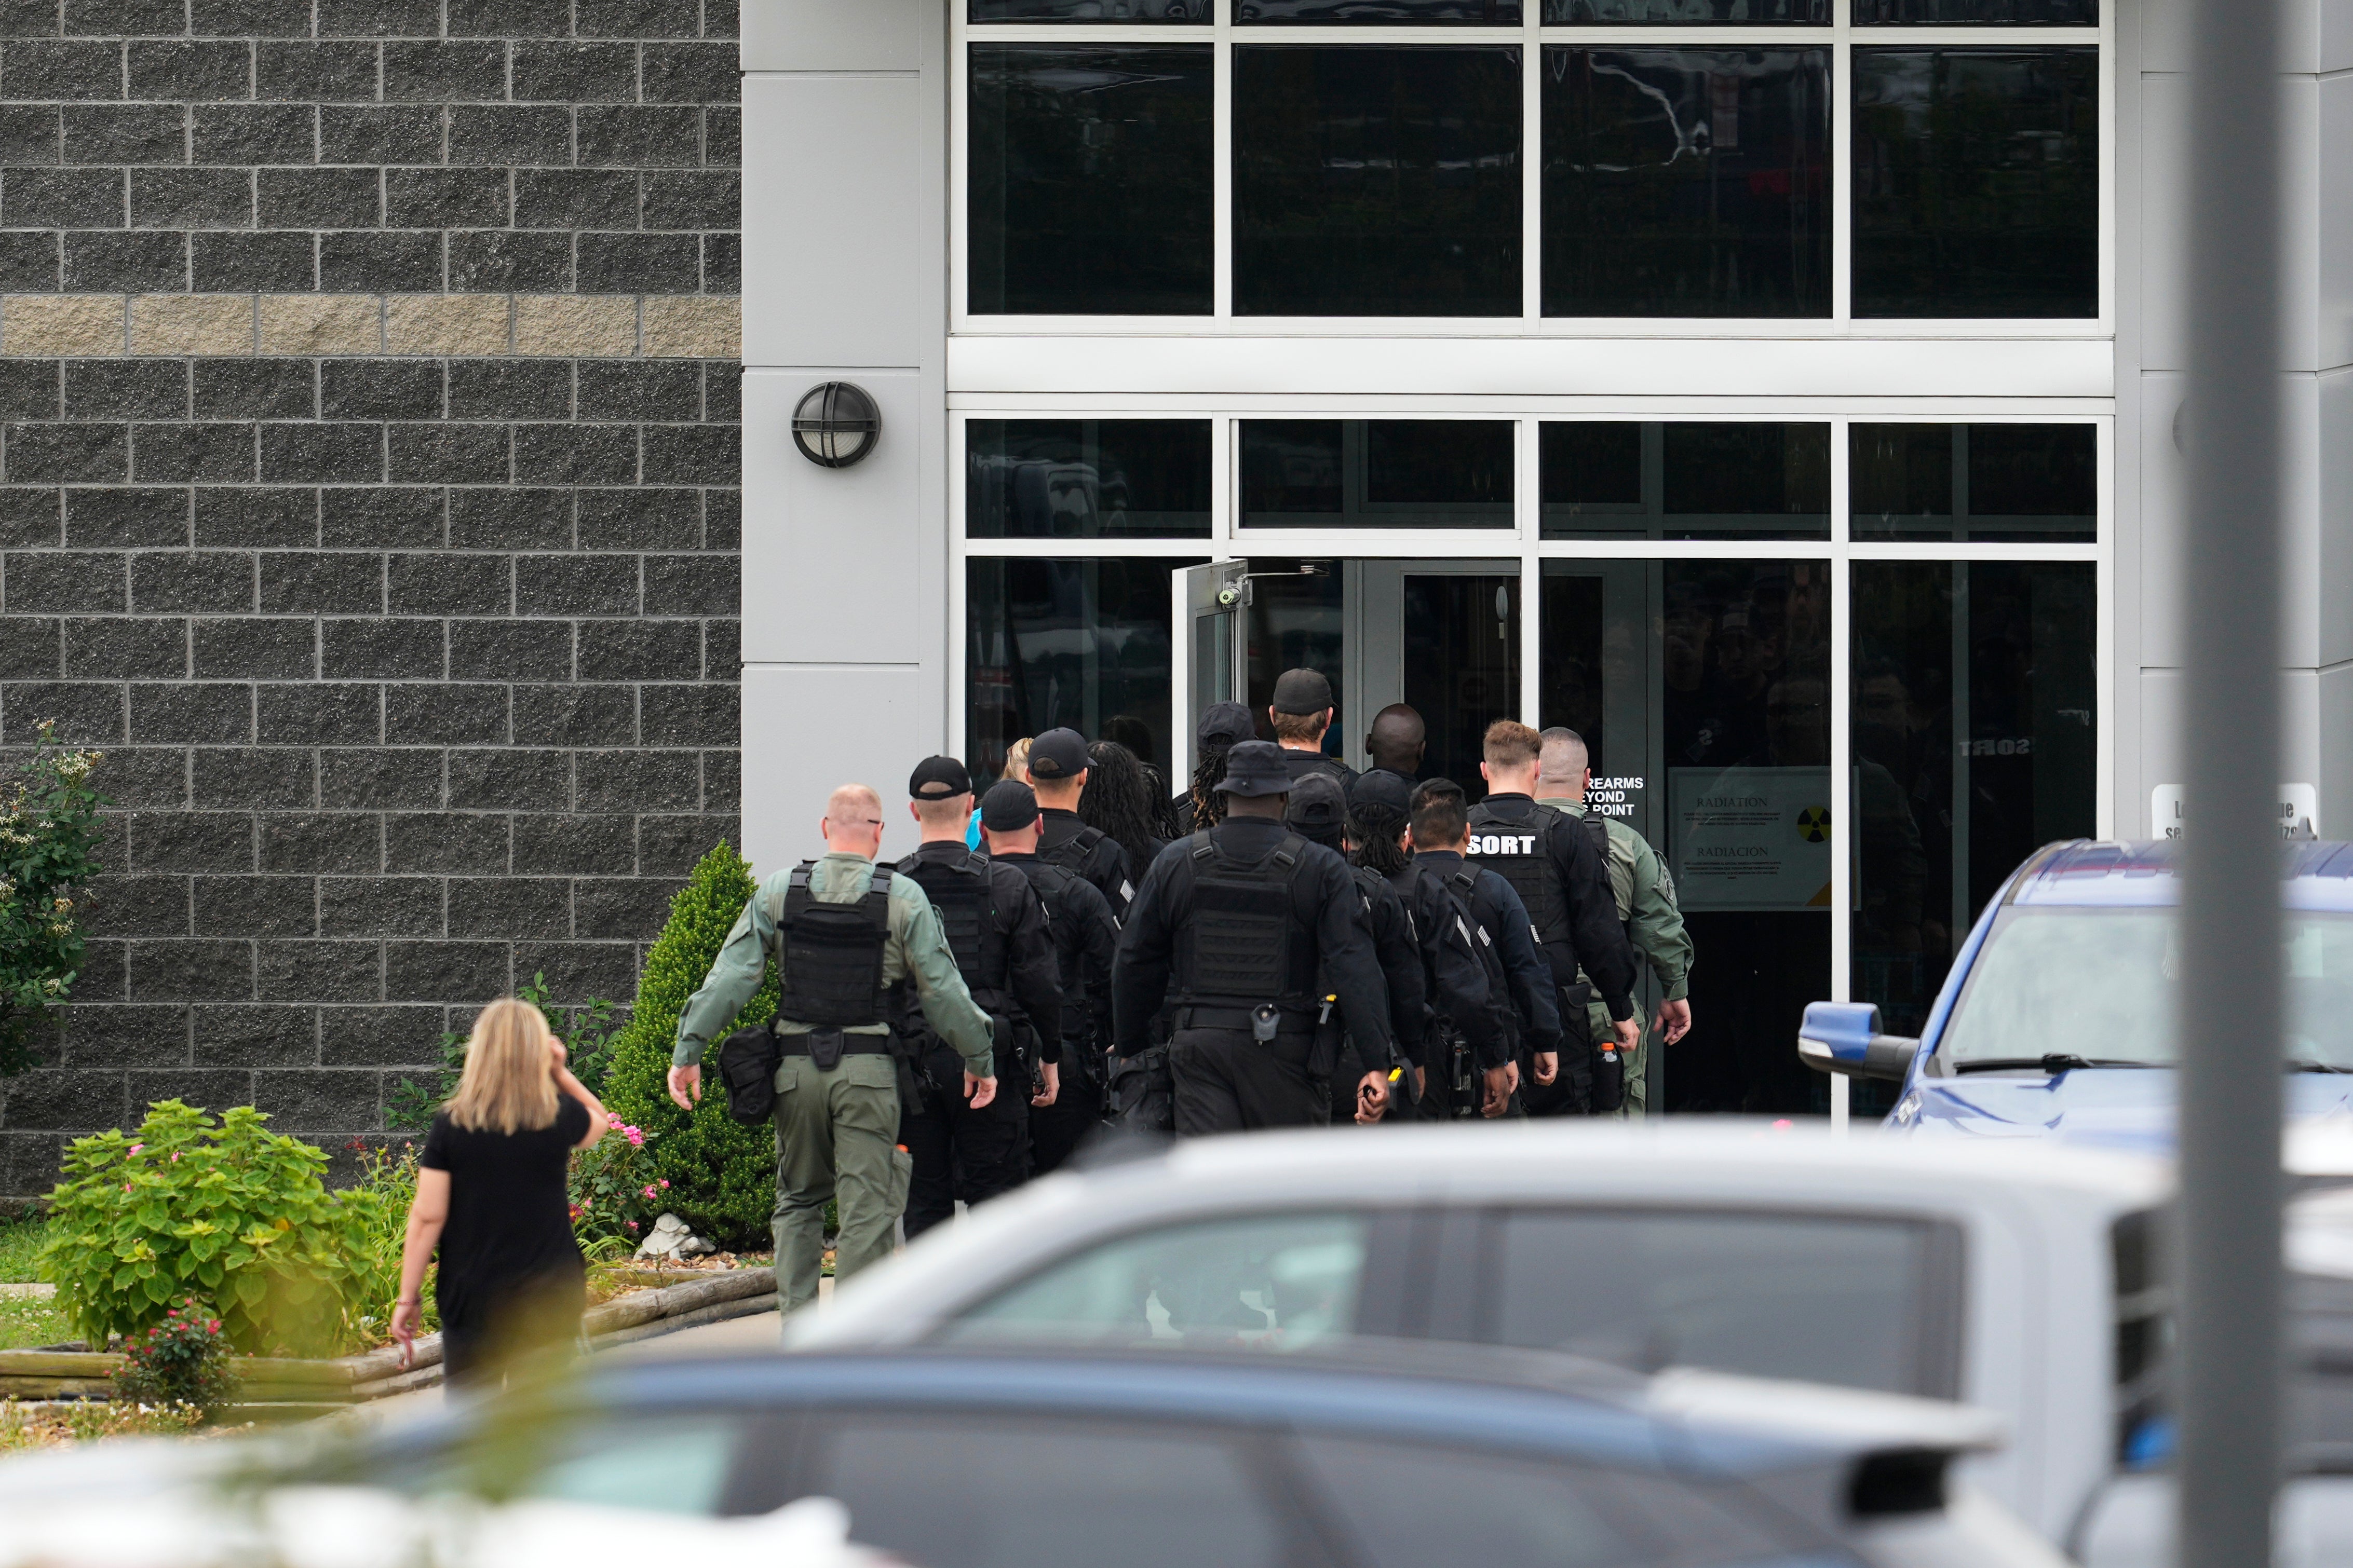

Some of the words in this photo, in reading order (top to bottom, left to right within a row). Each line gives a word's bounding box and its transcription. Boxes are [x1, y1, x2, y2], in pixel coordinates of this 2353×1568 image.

[1588, 777, 1644, 789] REARMS
[1696, 797, 1767, 807] RADIATION
[1466, 835, 1536, 855] SORT
